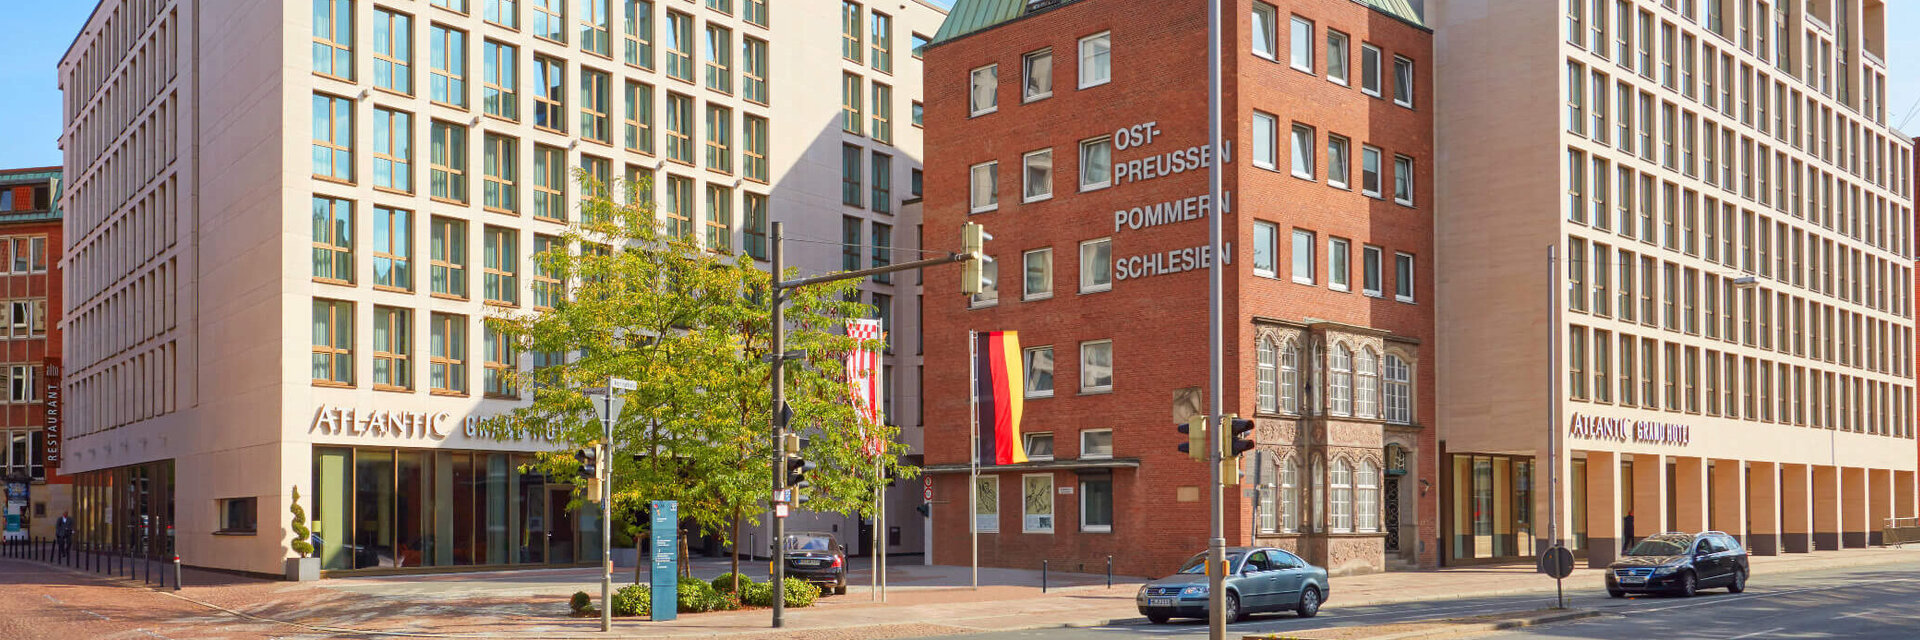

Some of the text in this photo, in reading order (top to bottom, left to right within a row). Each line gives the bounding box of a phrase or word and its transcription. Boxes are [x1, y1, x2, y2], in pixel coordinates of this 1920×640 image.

[1115, 121, 1161, 151] OST-
[1115, 140, 1231, 186] PREUSSEN
[1115, 190, 1230, 233] POMMERN
[1115, 242, 1231, 281] SCHLESIEN
[47, 384, 58, 461] RESTAURANT
[309, 403, 450, 440] ATLANTIC
